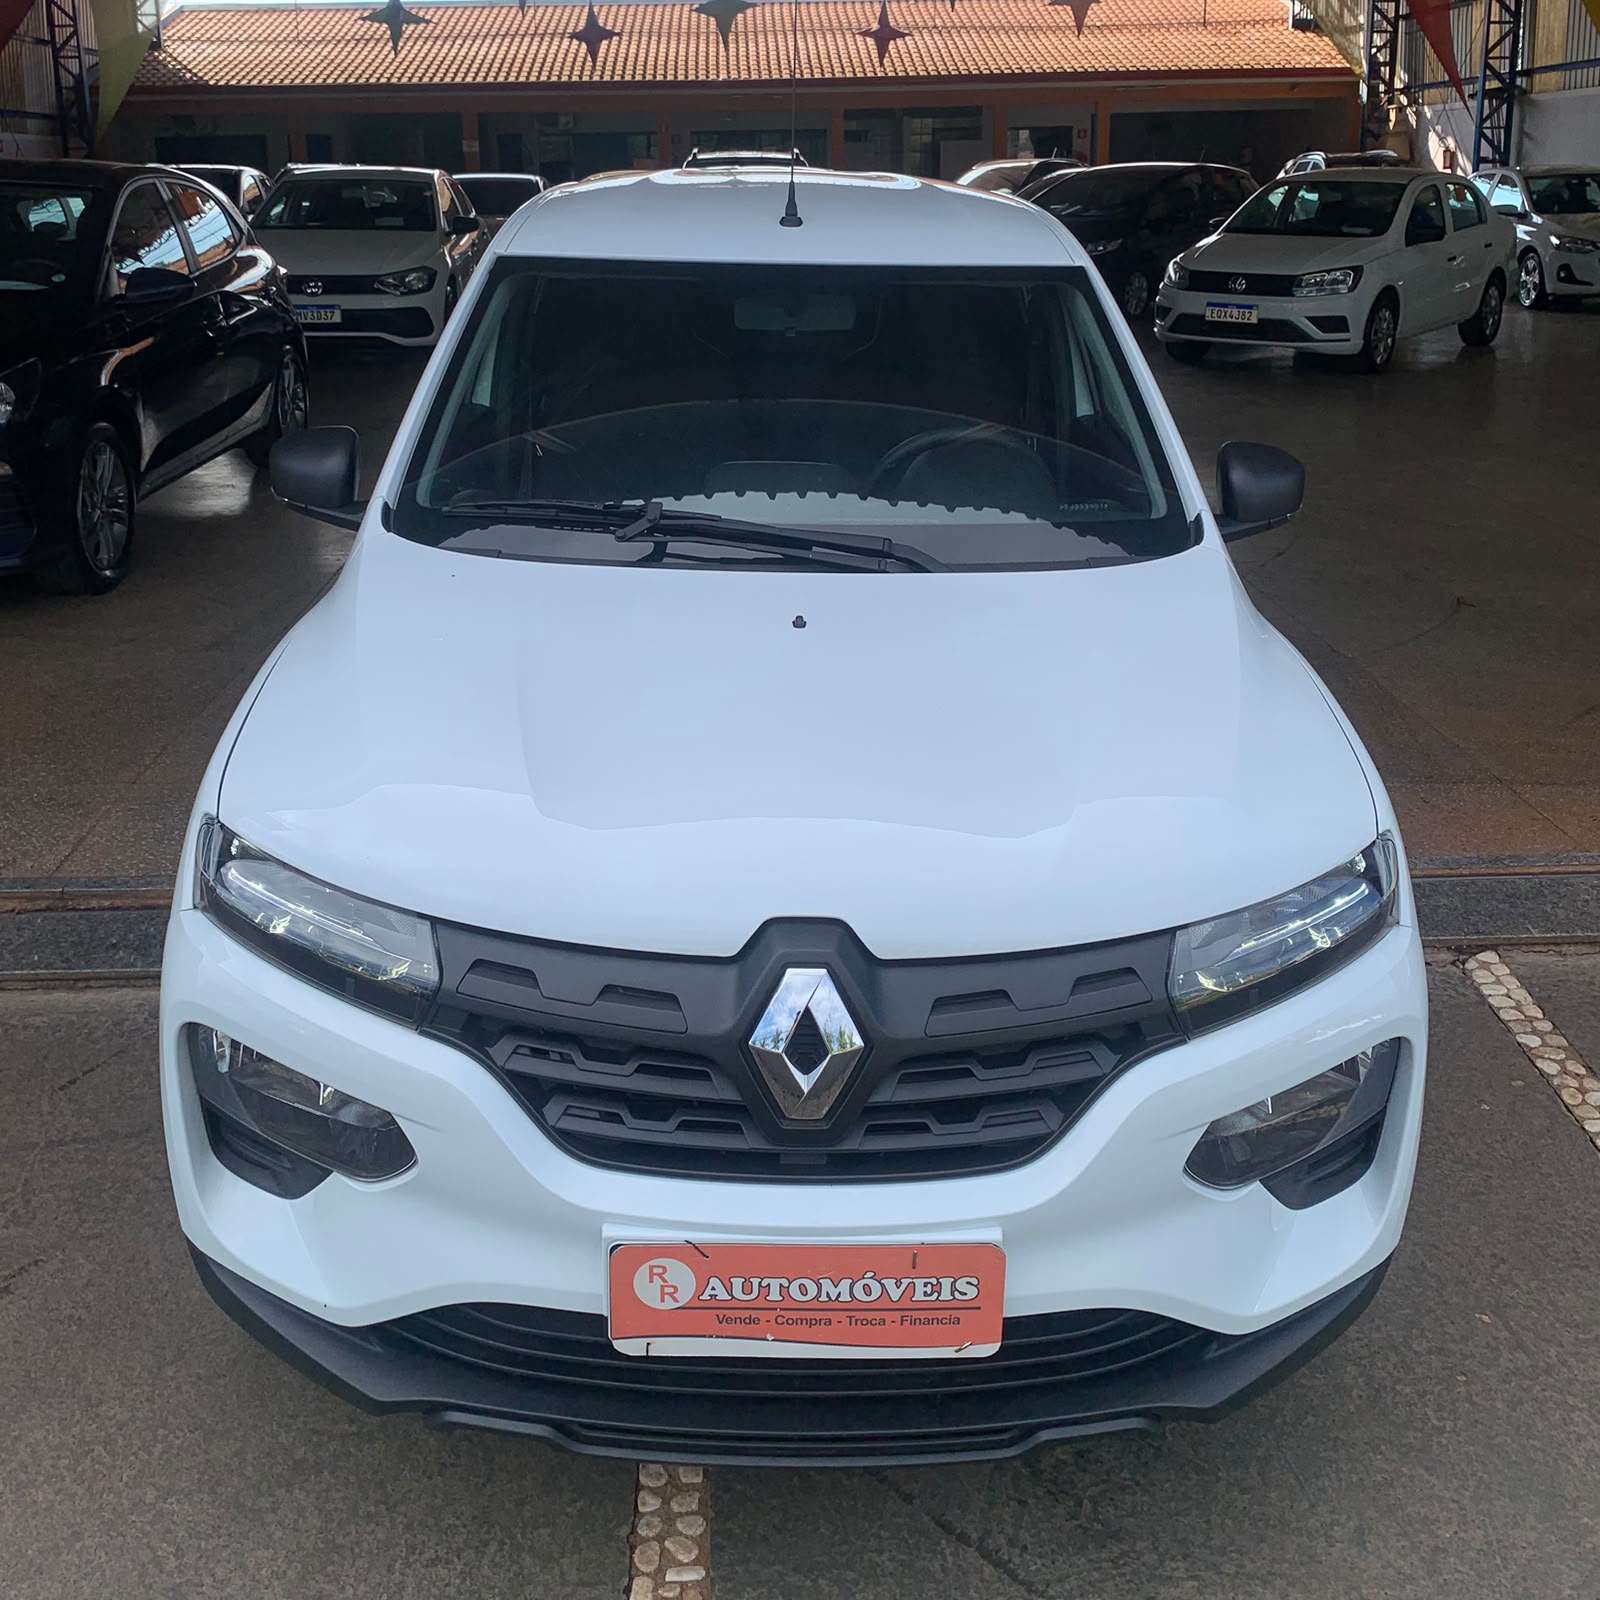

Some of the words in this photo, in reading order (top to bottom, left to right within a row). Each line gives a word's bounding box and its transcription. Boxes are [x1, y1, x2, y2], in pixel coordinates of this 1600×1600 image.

[698, 1270, 980, 1304] AUTOMÓVEIS
[715, 1313, 761, 1326] Vende
[774, 1314, 832, 1329] Compra
[846, 1315, 886, 1327] Troca
[900, 1314, 961, 1327] Financia
